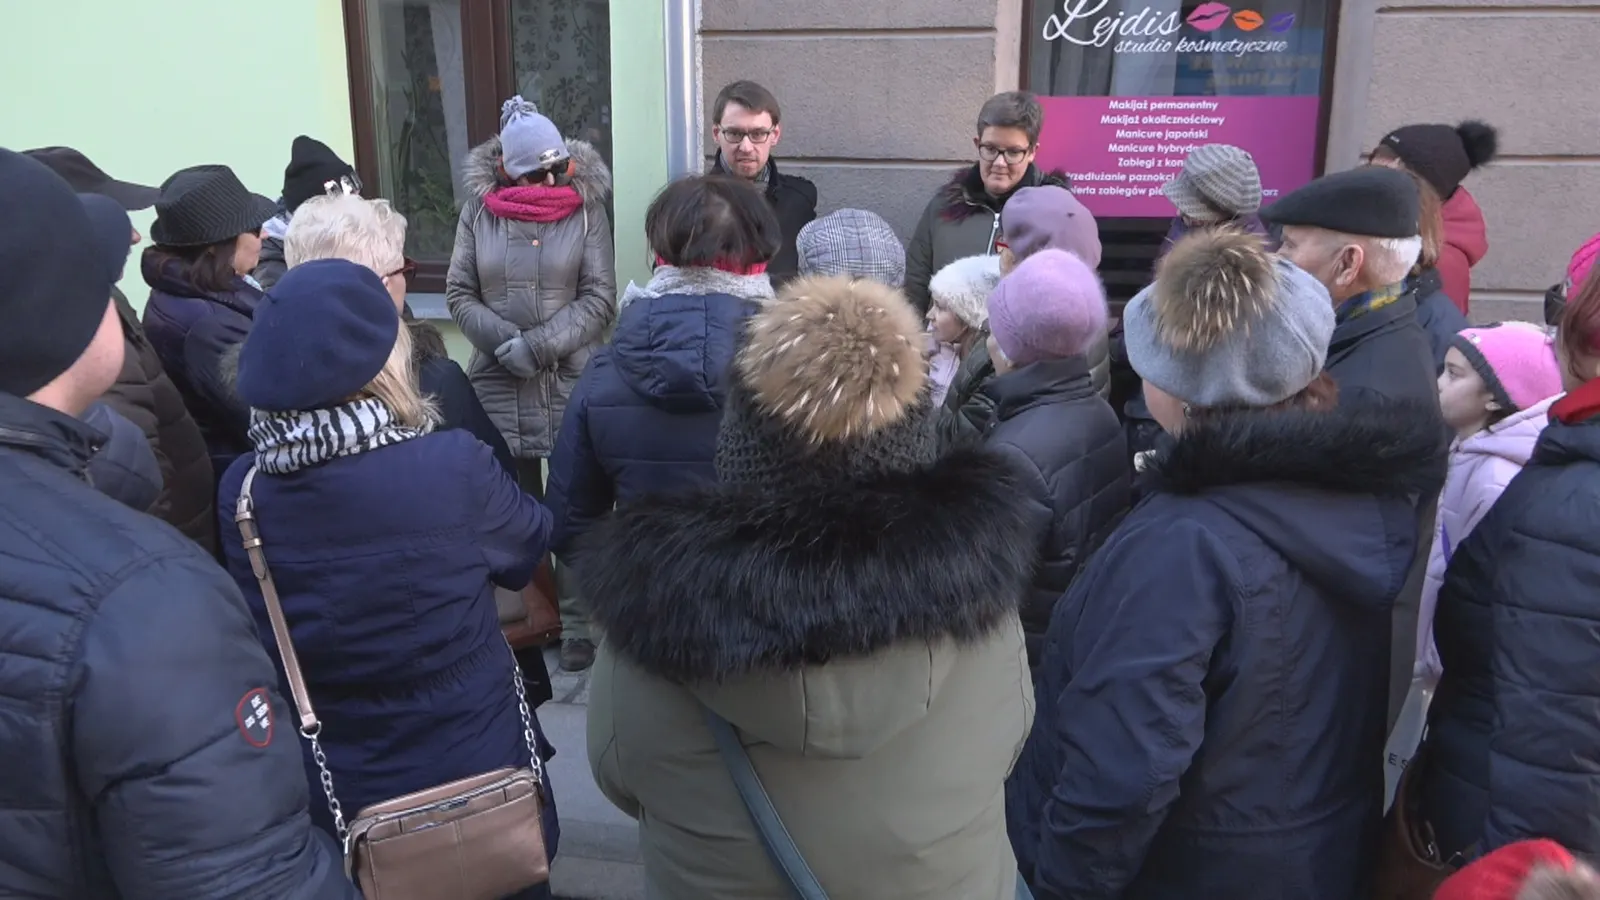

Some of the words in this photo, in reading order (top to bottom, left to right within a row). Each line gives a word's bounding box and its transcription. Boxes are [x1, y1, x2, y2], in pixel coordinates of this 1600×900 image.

[1043, 0, 1182, 47] Lejdis
[1114, 38, 1172, 53] studio
[1175, 37, 1288, 57] kosmetyczne
[1109, 100, 1148, 111] Makijaż
[1150, 100, 1218, 111] permanentny
[1101, 114, 1140, 126] Makijaż
[1142, 113, 1225, 126] okolicznościowy
[1116, 129, 1162, 139] Manicure
[1165, 128, 1209, 140] japoński
[1108, 143, 1155, 153] Manicure
[1118, 157, 1155, 168] Zabiegi
[1165, 157, 1184, 167] kon
[1129, 172, 1175, 182] paznokci
[1098, 185, 1146, 198] zabiegów
